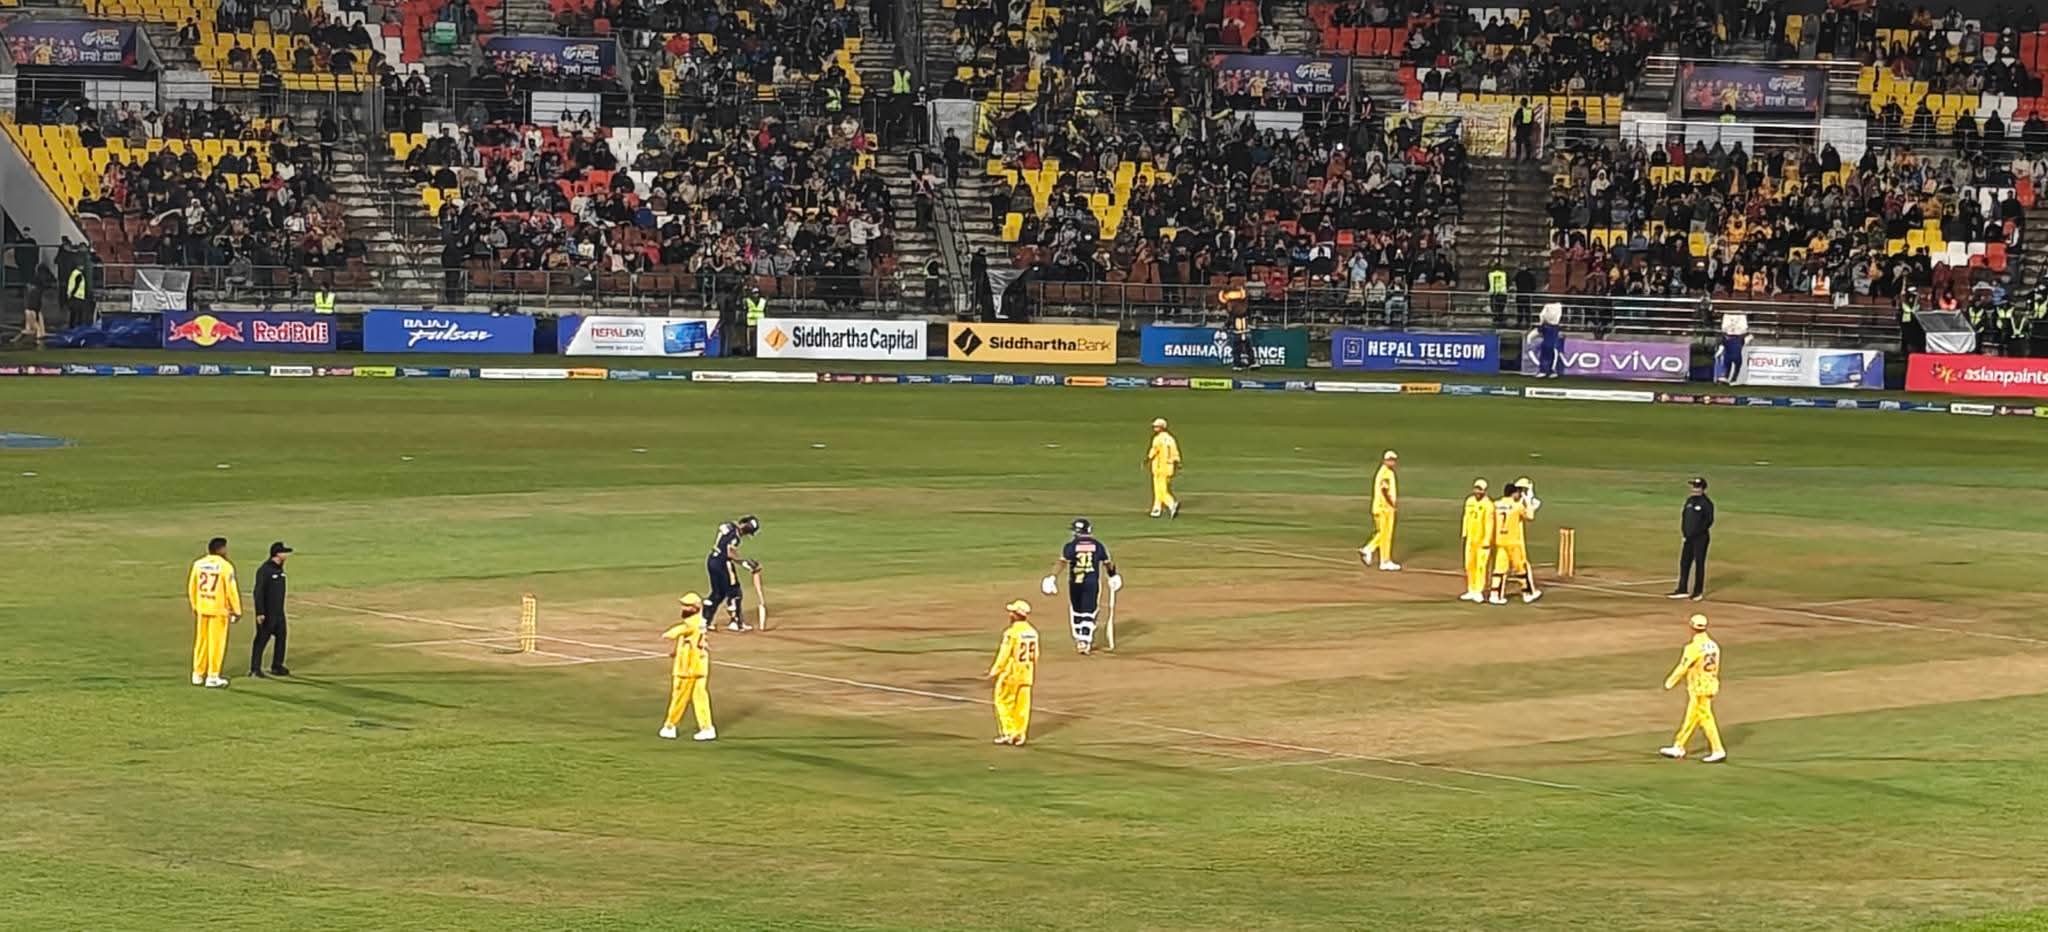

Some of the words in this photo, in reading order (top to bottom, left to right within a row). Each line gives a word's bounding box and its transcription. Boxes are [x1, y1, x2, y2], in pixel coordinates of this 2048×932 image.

[252, 320, 291, 342] Red
[292, 321, 329, 343] Bull
[403, 319, 449, 328] BAJAJ
[793, 326, 868, 349] Siddhartha
[870, 328, 918, 354] Capital
[1368, 341, 1414, 358] NEPAL
[1418, 343, 1486, 360] TELECOM
[1610, 350, 1683, 372] vivo
[1963, 366, 2048, 387] asianpaints
[199, 572, 219, 592] 27
